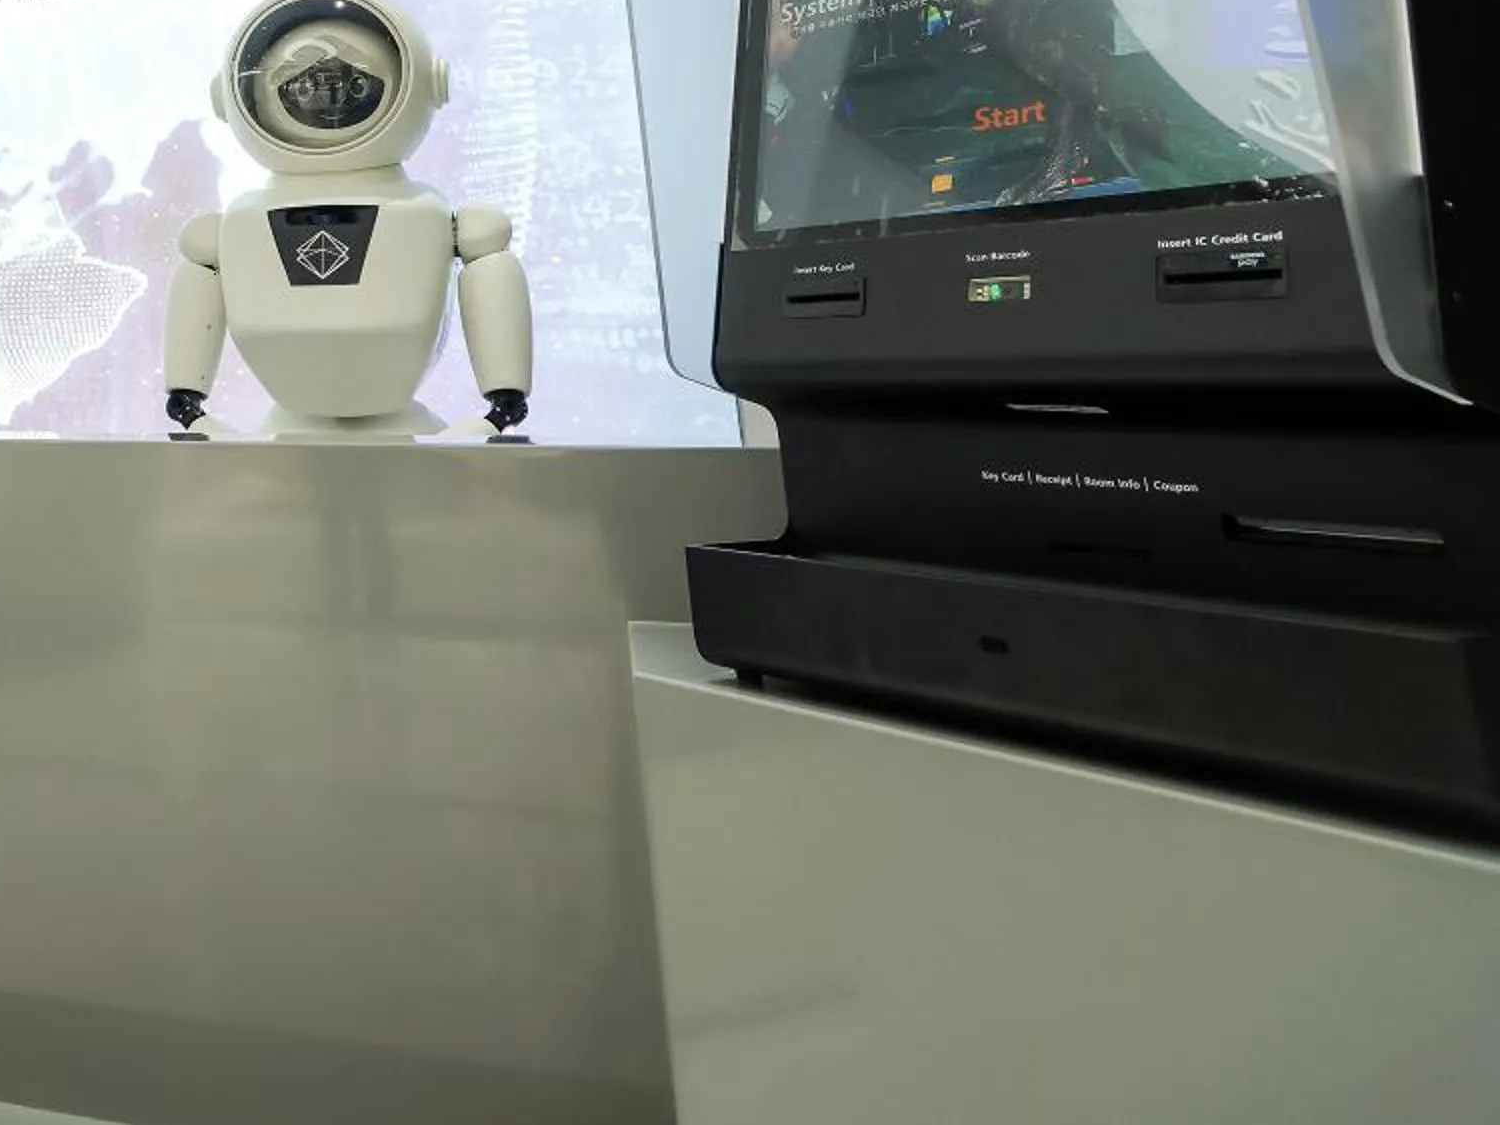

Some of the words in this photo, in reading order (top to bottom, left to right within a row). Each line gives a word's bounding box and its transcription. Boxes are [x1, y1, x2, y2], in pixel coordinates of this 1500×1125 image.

[972, 100, 1045, 131] Start
[1158, 238, 1191, 248] Insert
[1195, 237, 1207, 246] IC
[1211, 233, 1248, 245] Credit
[1252, 230, 1283, 242] Card
[1001, 472, 1025, 482] Card
[1153, 480, 1199, 494] Coupon
